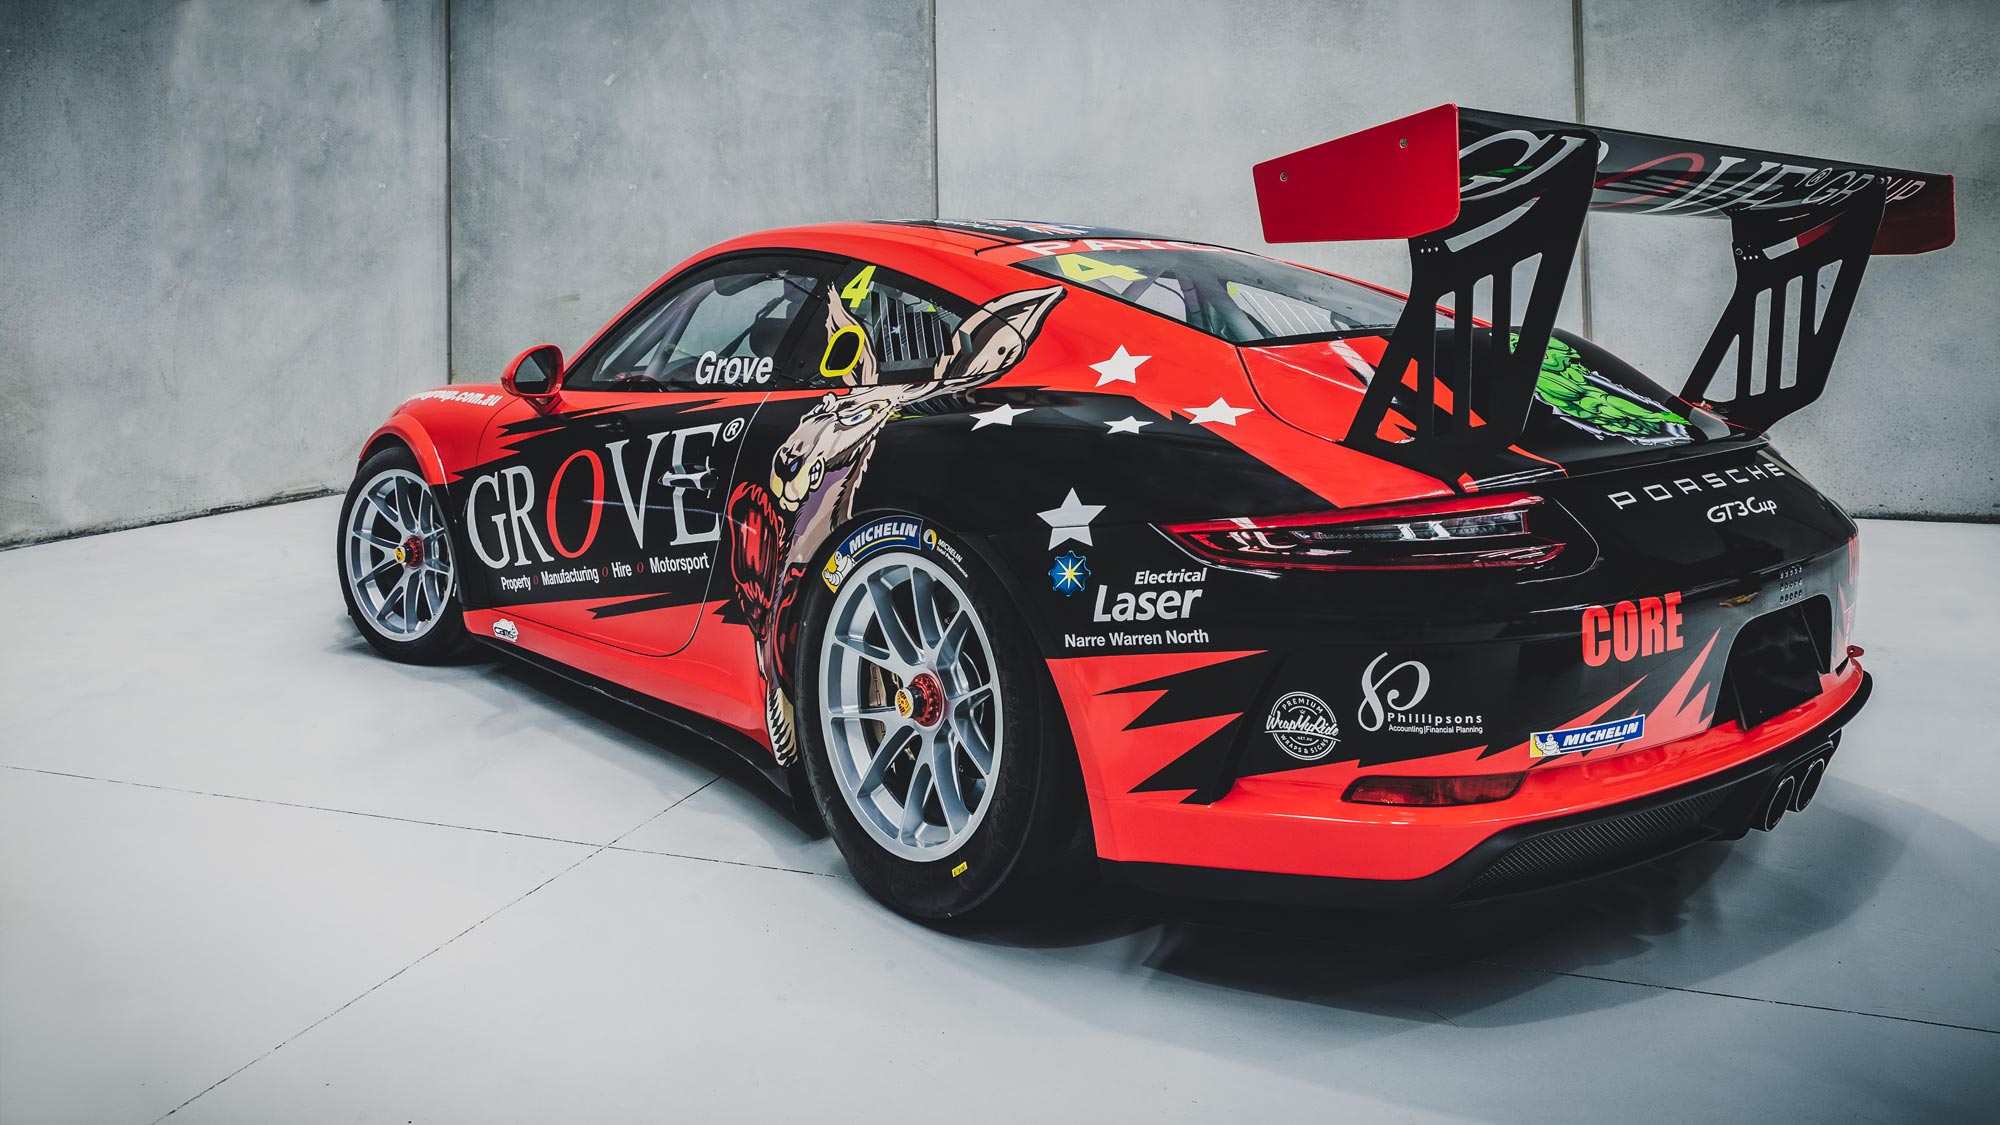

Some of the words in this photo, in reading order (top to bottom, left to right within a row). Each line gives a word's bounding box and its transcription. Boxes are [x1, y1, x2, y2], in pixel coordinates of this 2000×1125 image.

[1801, 171, 1926, 206] GRUP
[1056, 253, 1148, 282] 4
[840, 265, 877, 308] 4
[695, 350, 774, 385] Grove
[1607, 463, 1786, 510] PORSCHE
[848, 521, 918, 554] MICHELIN
[937, 538, 963, 563] MICHELIN
[501, 574, 532, 592] Property
[540, 566, 600, 587] Manufacturing
[611, 560, 633, 579] Hire
[649, 552, 710, 576] Motorsport
[1134, 567, 1208, 585] Electrical
[1093, 584, 1203, 622] Laser
[1064, 633, 1106, 648] Narre
[1108, 631, 1162, 647] Warren
[1165, 629, 1209, 644] North
[1581, 591, 1684, 667] CORE
[1281, 697, 1323, 714] PREMIUM
[1387, 712, 1482, 726] Phillipsons
[1265, 710, 1339, 737] WrapMyRide
[1455, 726, 1483, 735] Planning
[1562, 722, 1639, 747] MICHELIN
[1281, 734, 1302, 753] WRAPS
[1310, 738, 1329, 754] SIGNS
